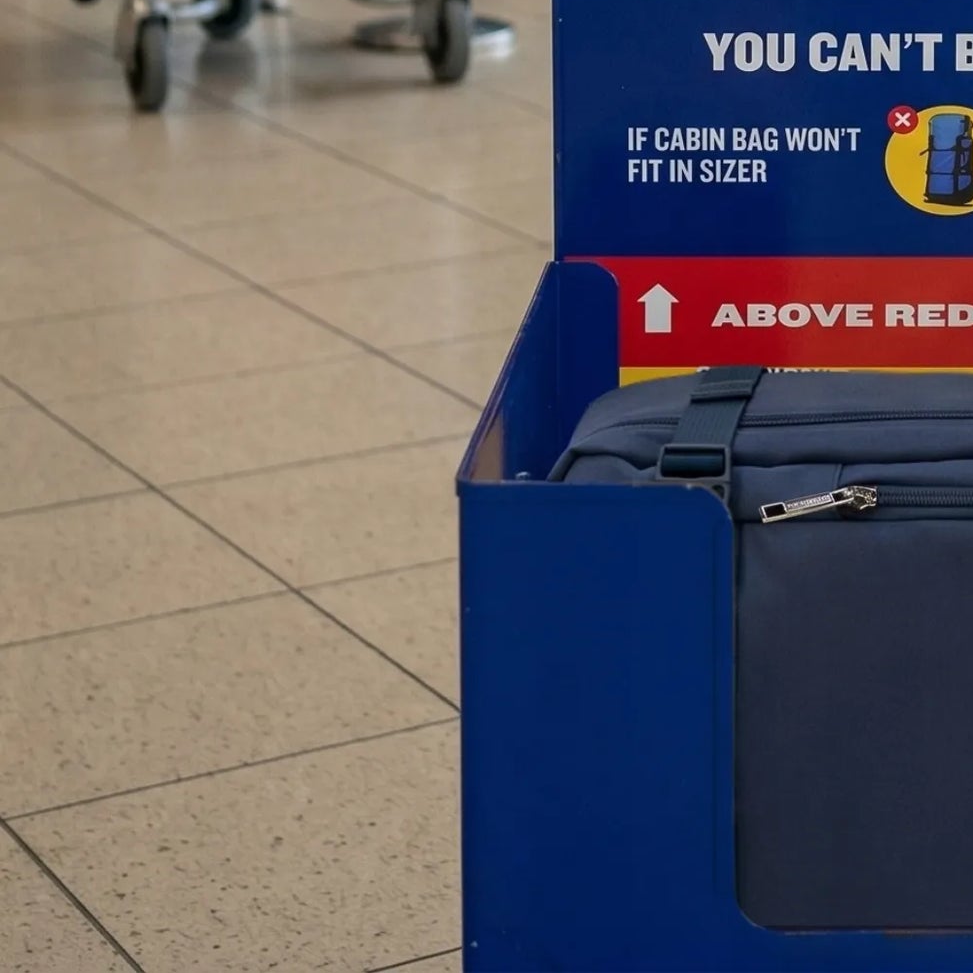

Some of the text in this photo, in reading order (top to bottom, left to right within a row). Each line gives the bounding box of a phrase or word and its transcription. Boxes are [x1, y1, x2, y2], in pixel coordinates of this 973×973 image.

[703, 32, 796, 72] YOU
[809, 32, 943, 72] CAN'T
[628, 127, 861, 151] IF CABIN BAG WON'T
[628, 159, 767, 183] FIT IN SIZER
[711, 302, 873, 328] ABOVE
